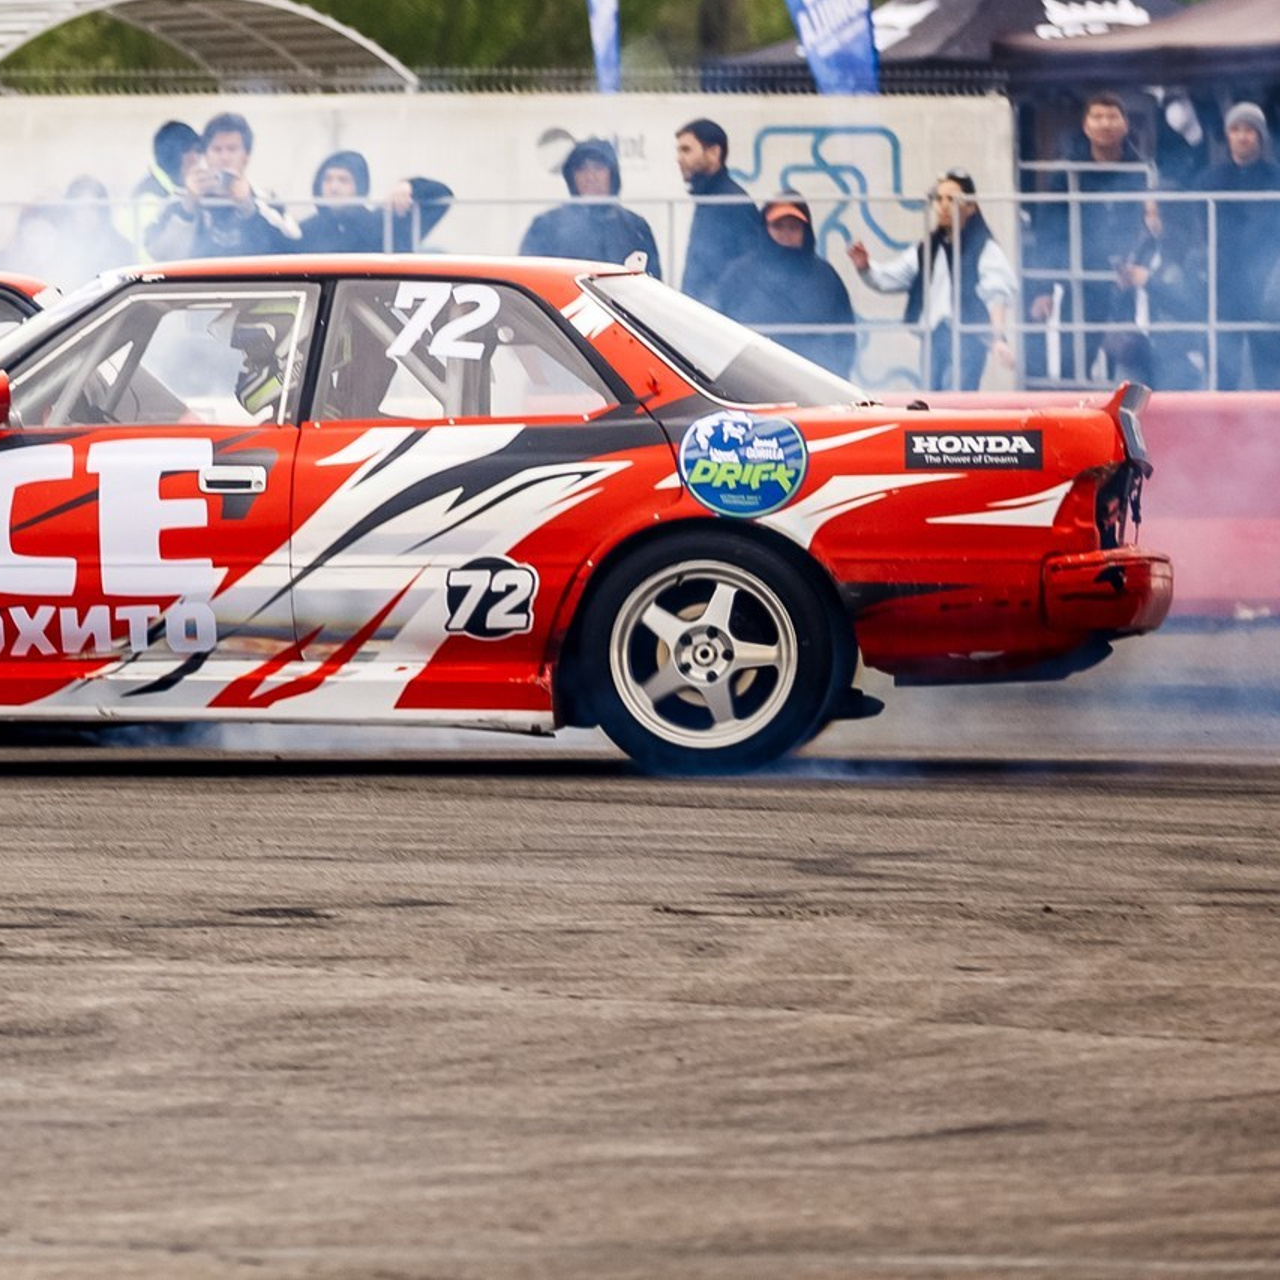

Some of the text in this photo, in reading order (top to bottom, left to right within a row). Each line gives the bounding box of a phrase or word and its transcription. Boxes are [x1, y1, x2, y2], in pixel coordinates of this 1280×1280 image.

[385, 280, 501, 360] 72
[911, 434, 1036, 454] HONDA
[924, 454, 1019, 464] The Power of Dreams
[688, 458, 796, 495] DRIFT
[445, 568, 537, 632] 72
